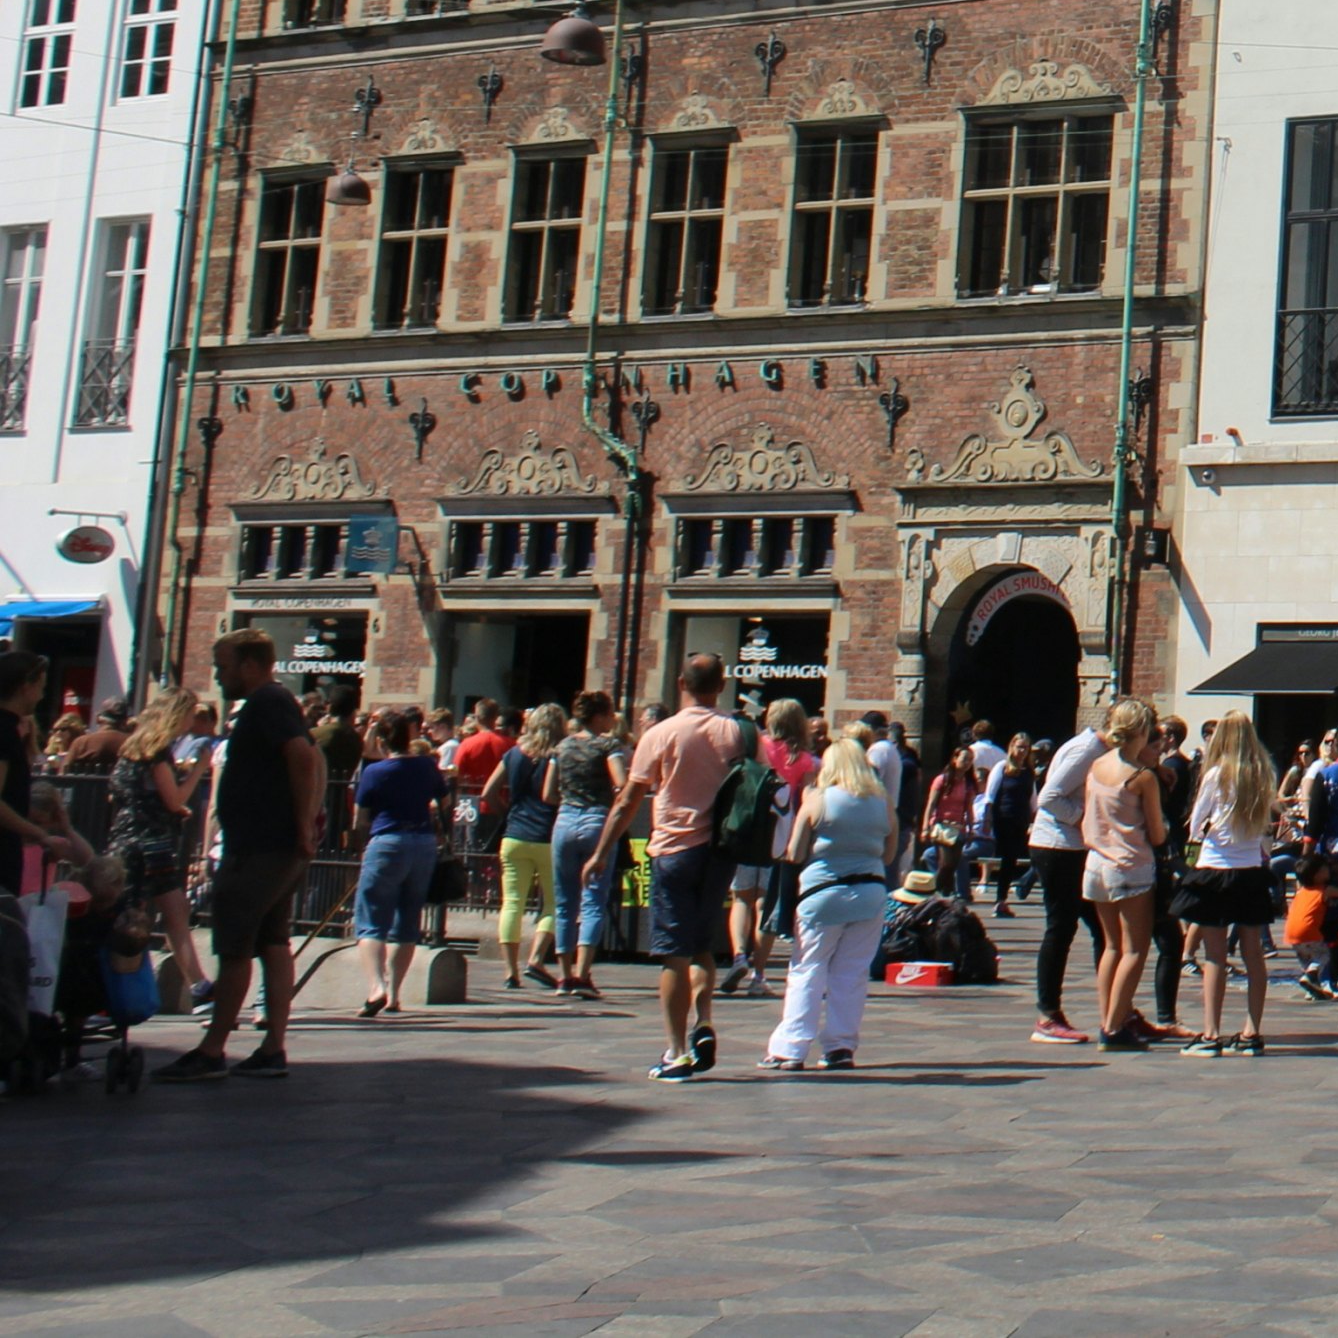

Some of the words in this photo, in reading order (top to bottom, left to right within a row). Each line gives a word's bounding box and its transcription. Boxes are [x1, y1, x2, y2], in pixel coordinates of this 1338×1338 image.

[231, 376, 396, 408] ROYAL
[460, 354, 877, 398] COPNHAGEN
[977, 585, 1013, 621] ROYAL
[733, 664, 829, 679] COPENHAGEN
